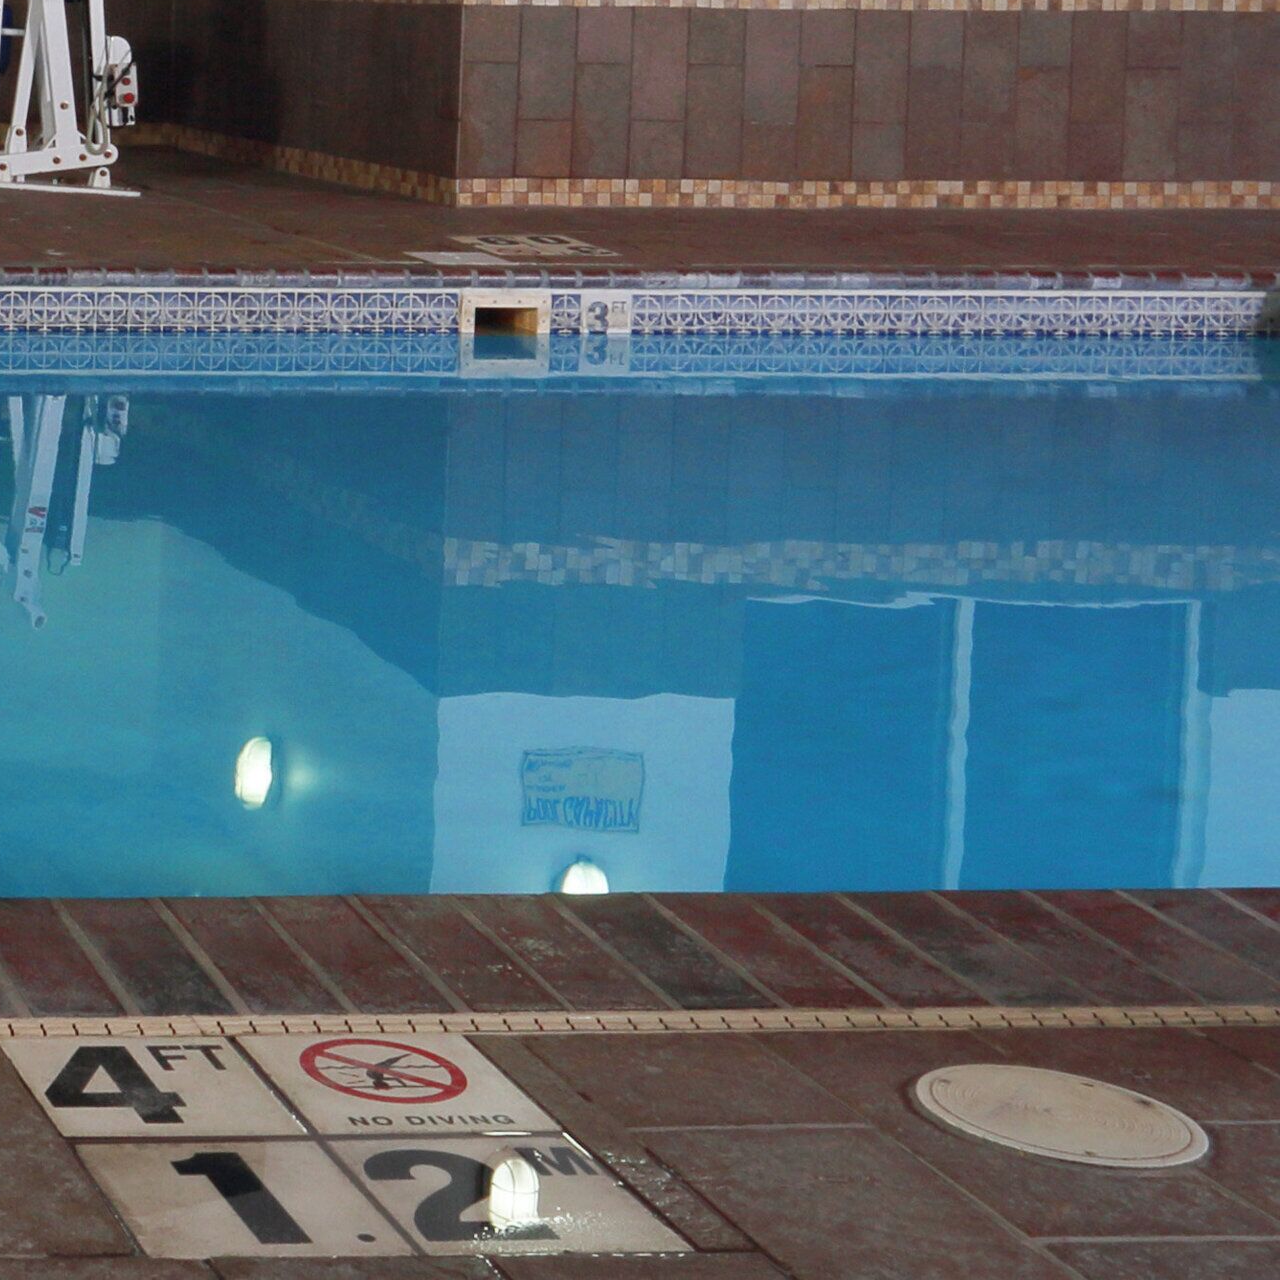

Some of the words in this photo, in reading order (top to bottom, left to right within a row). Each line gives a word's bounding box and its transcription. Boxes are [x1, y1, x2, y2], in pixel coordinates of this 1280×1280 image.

[588, 301, 609, 334] 3
[611, 301, 627, 313] FT
[45, 1046, 187, 1123] 4
[145, 1045, 227, 1071] FT
[347, 1115, 393, 1127] NO
[405, 1114, 516, 1126] DIVING
[514, 1147, 599, 1176] M
